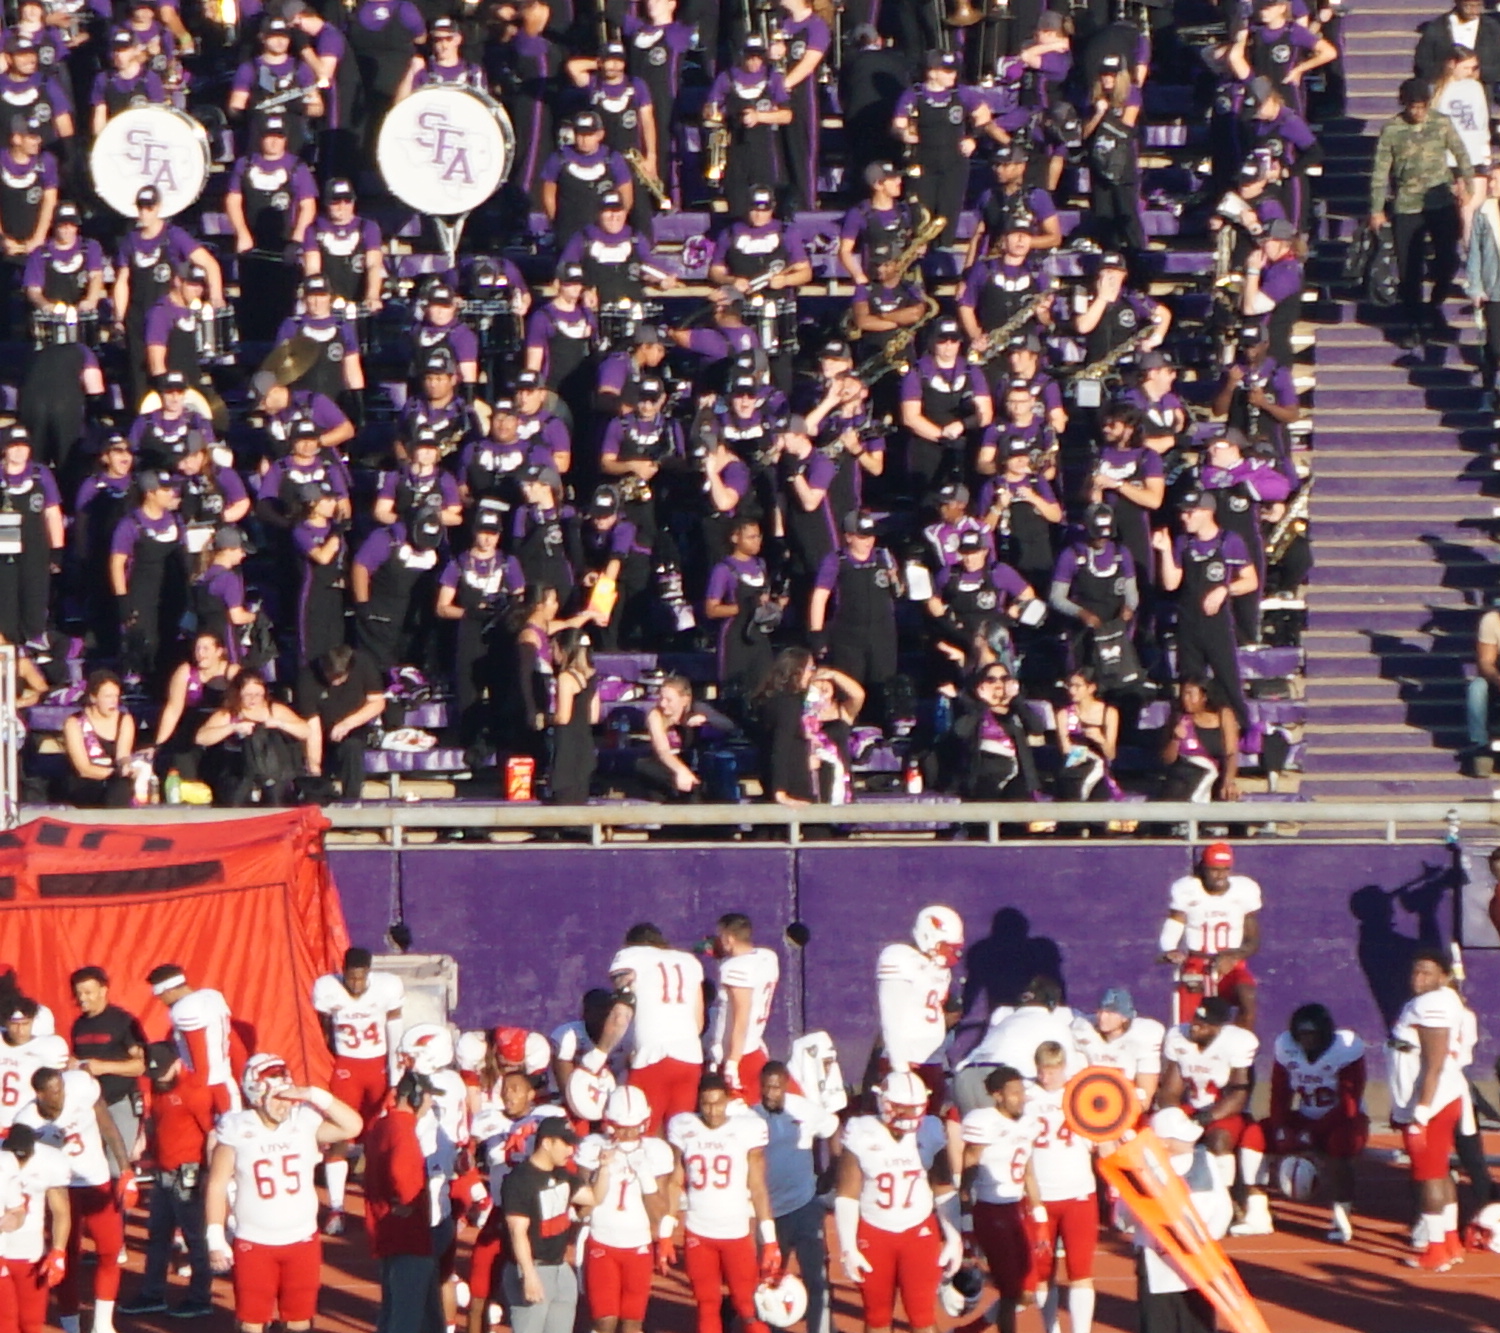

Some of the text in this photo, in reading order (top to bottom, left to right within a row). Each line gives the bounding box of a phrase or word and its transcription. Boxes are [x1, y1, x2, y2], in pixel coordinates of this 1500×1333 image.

[127, 128, 179, 194] SFA
[417, 110, 476, 185] SFA
[1200, 921, 1229, 953] 10
[657, 961, 686, 1004] 11
[337, 1021, 386, 1050] 34
[1033, 1116, 1073, 1149] 24
[252, 1153, 301, 1199] 65
[687, 1153, 733, 1191] 39
[876, 1169, 923, 1209] 97
